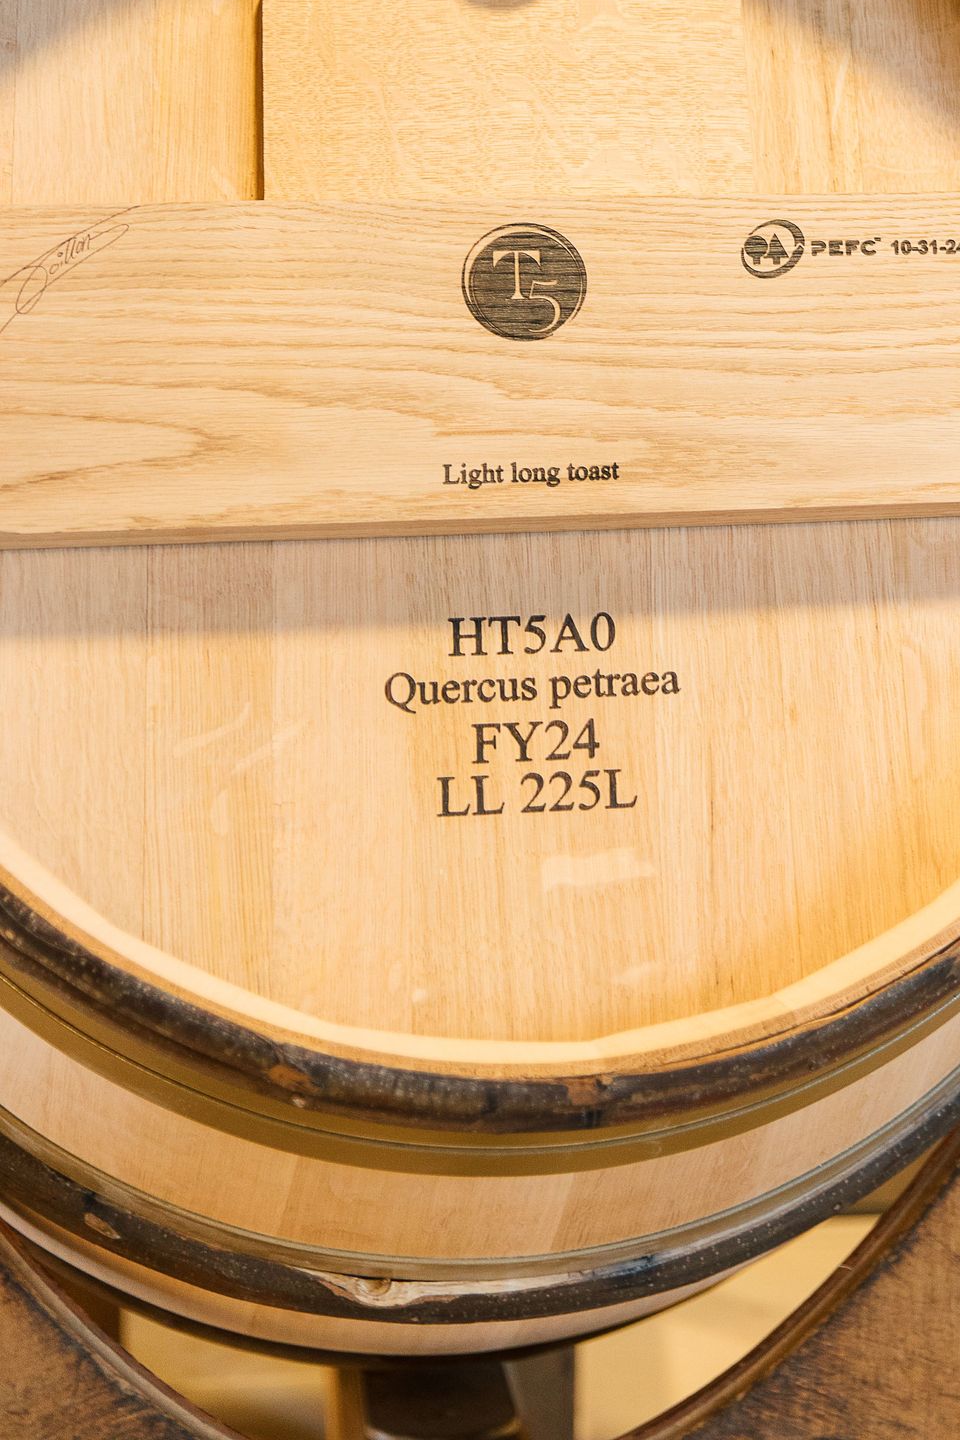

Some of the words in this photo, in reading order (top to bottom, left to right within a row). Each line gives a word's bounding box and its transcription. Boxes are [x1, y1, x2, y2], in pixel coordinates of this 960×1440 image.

[492, 250, 561, 333] T5
[443, 462, 504, 490] Light
[510, 462, 561, 488] long
[566, 462, 620, 482] toast
[447, 611, 617, 657] HT5A0
[384, 672, 538, 714] Quercus
[548, 668, 681, 709] petraea
[471, 718, 600, 764] FY24
[436, 774, 505, 817] LL
[519, 769, 638, 813] 225L
